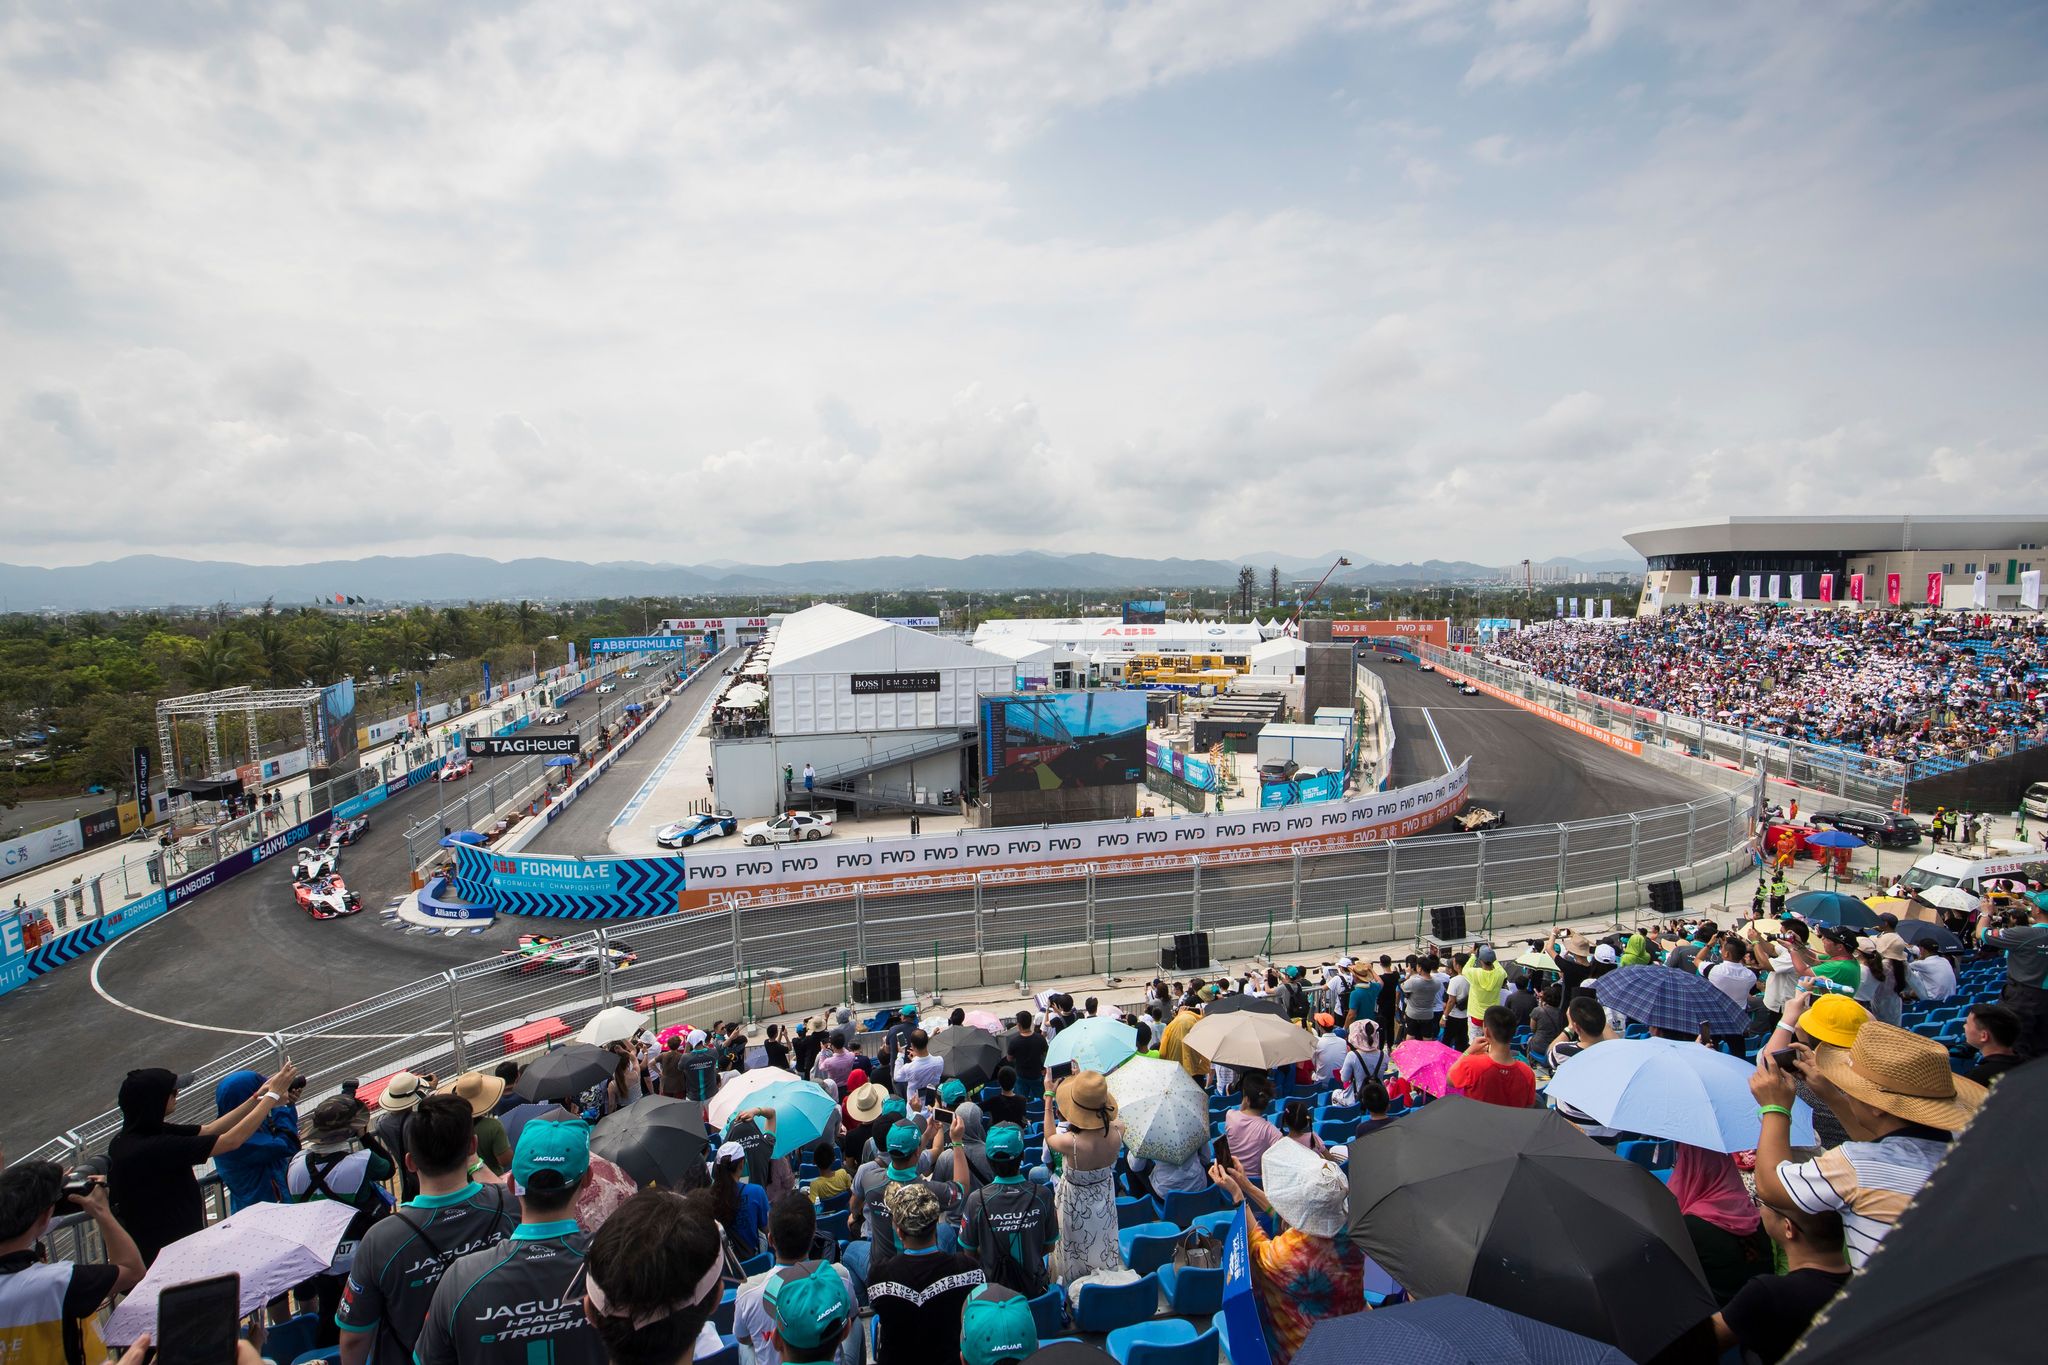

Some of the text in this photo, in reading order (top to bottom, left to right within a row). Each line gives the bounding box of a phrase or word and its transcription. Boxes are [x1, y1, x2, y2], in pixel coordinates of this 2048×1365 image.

[677, 620, 723, 629] ABB ABB
[748, 618, 766, 626] ABB
[908, 618, 923, 626] HKT
[1102, 628, 1157, 636] ABB
[1396, 624, 1416, 632] FWD
[855, 678, 936, 688] BOSS EMOTION
[1612, 735, 1623, 748] FWD
[1402, 820, 1420, 835] FWD
[690, 866, 726, 880] FWD
[736, 862, 772, 876] FWD
[782, 858, 818, 872] FWD
[837, 854, 872, 868] FWD
[882, 850, 916, 864] FWD
[925, 848, 958, 860] FWD
[967, 844, 1000, 858] FWD
[1009, 841, 1041, 854] FWD
[1050, 838, 1082, 850] FWD
[1098, 834, 1129, 847] FWD
[1137, 831, 1168, 844] FWD
[1176, 828, 1205, 841] FWD
[1216, 825, 1246, 838] FWD
[1253, 822, 1281, 834] FWD
[1288, 818, 1312, 830] FWD
[1322, 813, 1347, 826] FWD
[1352, 808, 1373, 821] FWD
[1378, 804, 1397, 816] FWD
[1401, 798, 1415, 811] FWD
[1418, 792, 1434, 806] FWD
[493, 860, 610, 879] ABB FORMULA-E
[176, 871, 216, 900] FANBOOST
[550, 883, 610, 892] CHAMPIONSHIP
[434, 908, 458, 918] Allianz
[989, 1208, 1040, 1220] JAGUAR
[526, 1252, 556, 1260] JAGUAR
[476, 1298, 582, 1320] JAGUA
[816, 1302, 842, 1322] JAGUAR
[506, 1310, 574, 1328] I-PACE
[992, 1343, 1023, 1352] JAGUAR
